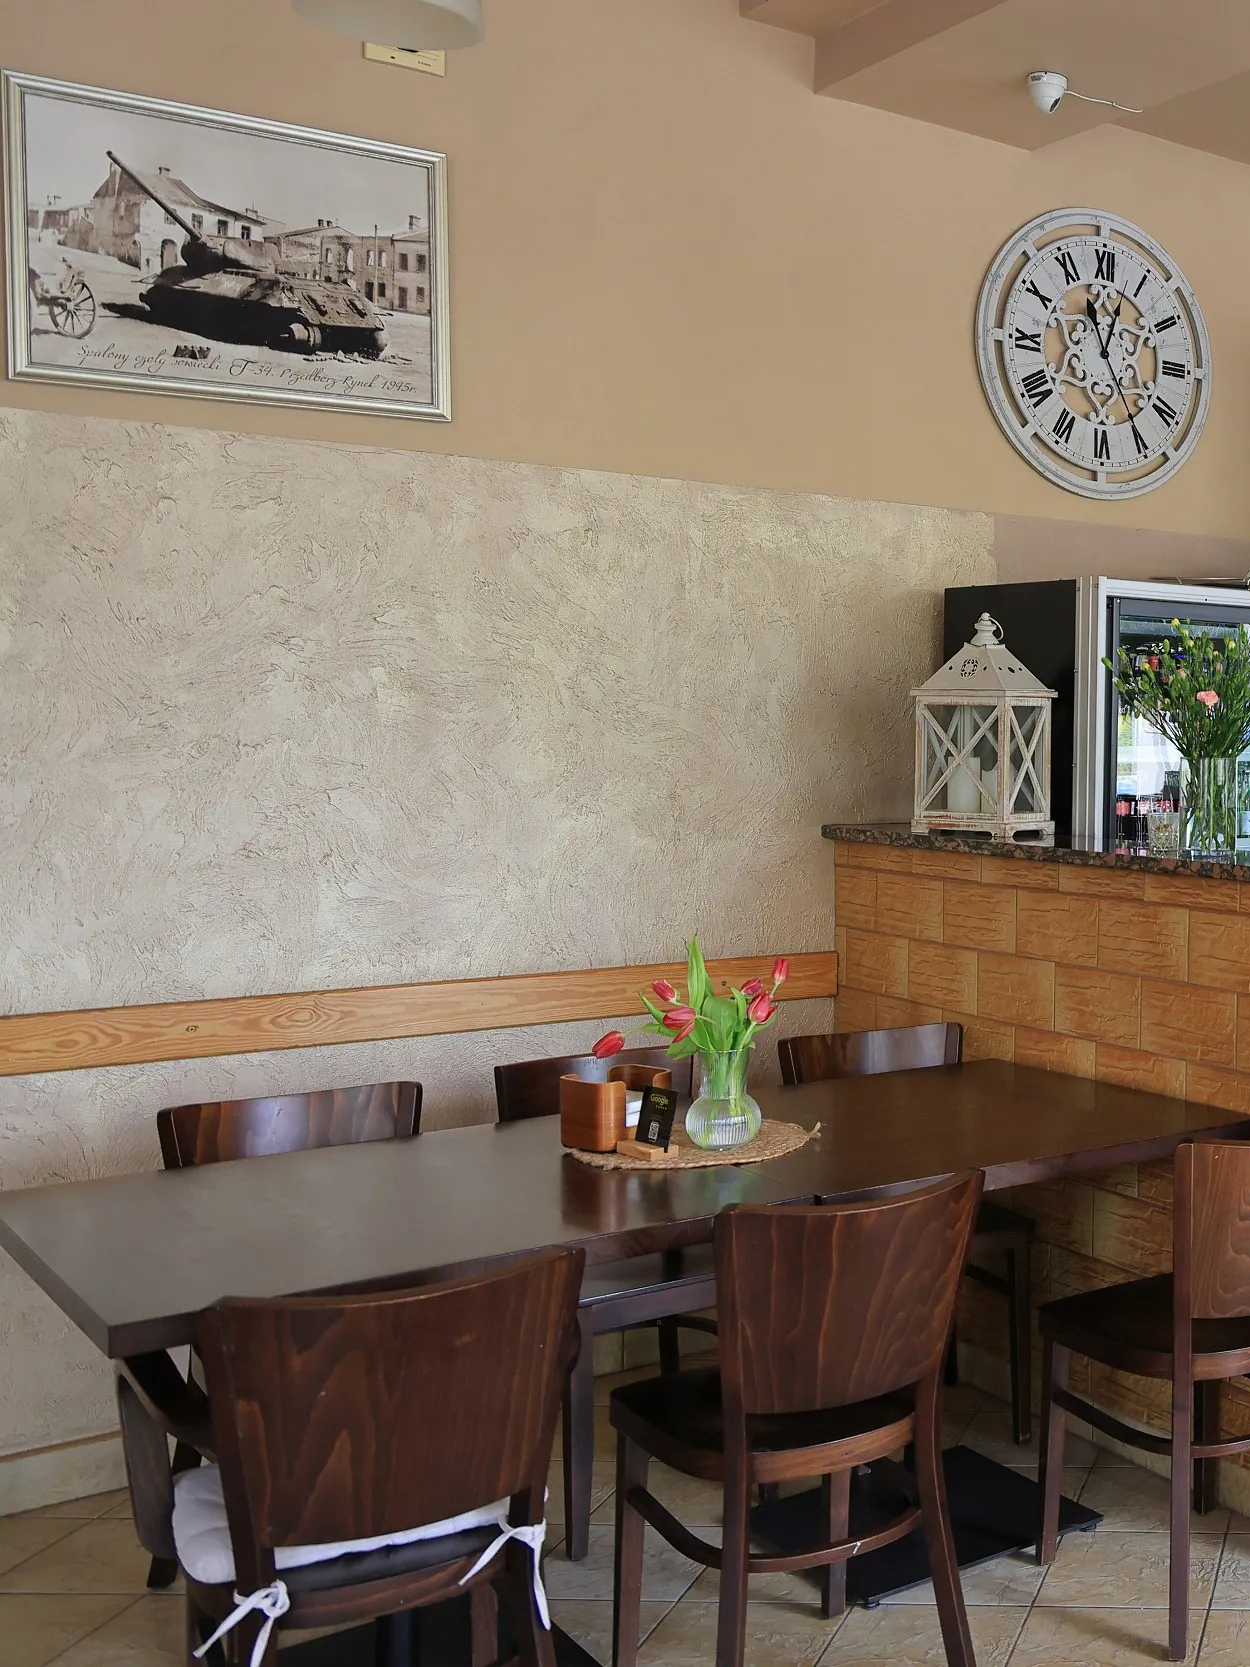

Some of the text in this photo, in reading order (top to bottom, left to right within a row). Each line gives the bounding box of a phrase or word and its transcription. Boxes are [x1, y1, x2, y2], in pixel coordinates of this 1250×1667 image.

[1054, 250, 1081, 286] XI
[1094, 248, 1116, 283] XII
[1025, 279, 1053, 311] X
[1133, 274, 1148, 298] I
[1014, 327, 1042, 353] IX
[1154, 315, 1178, 334] II
[1161, 360, 1186, 379] III
[1021, 368, 1054, 409] VIII
[1051, 407, 1076, 444] VII
[1151, 395, 1178, 428] IV
[1093, 427, 1111, 461] VI
[1131, 424, 1149, 455] V
